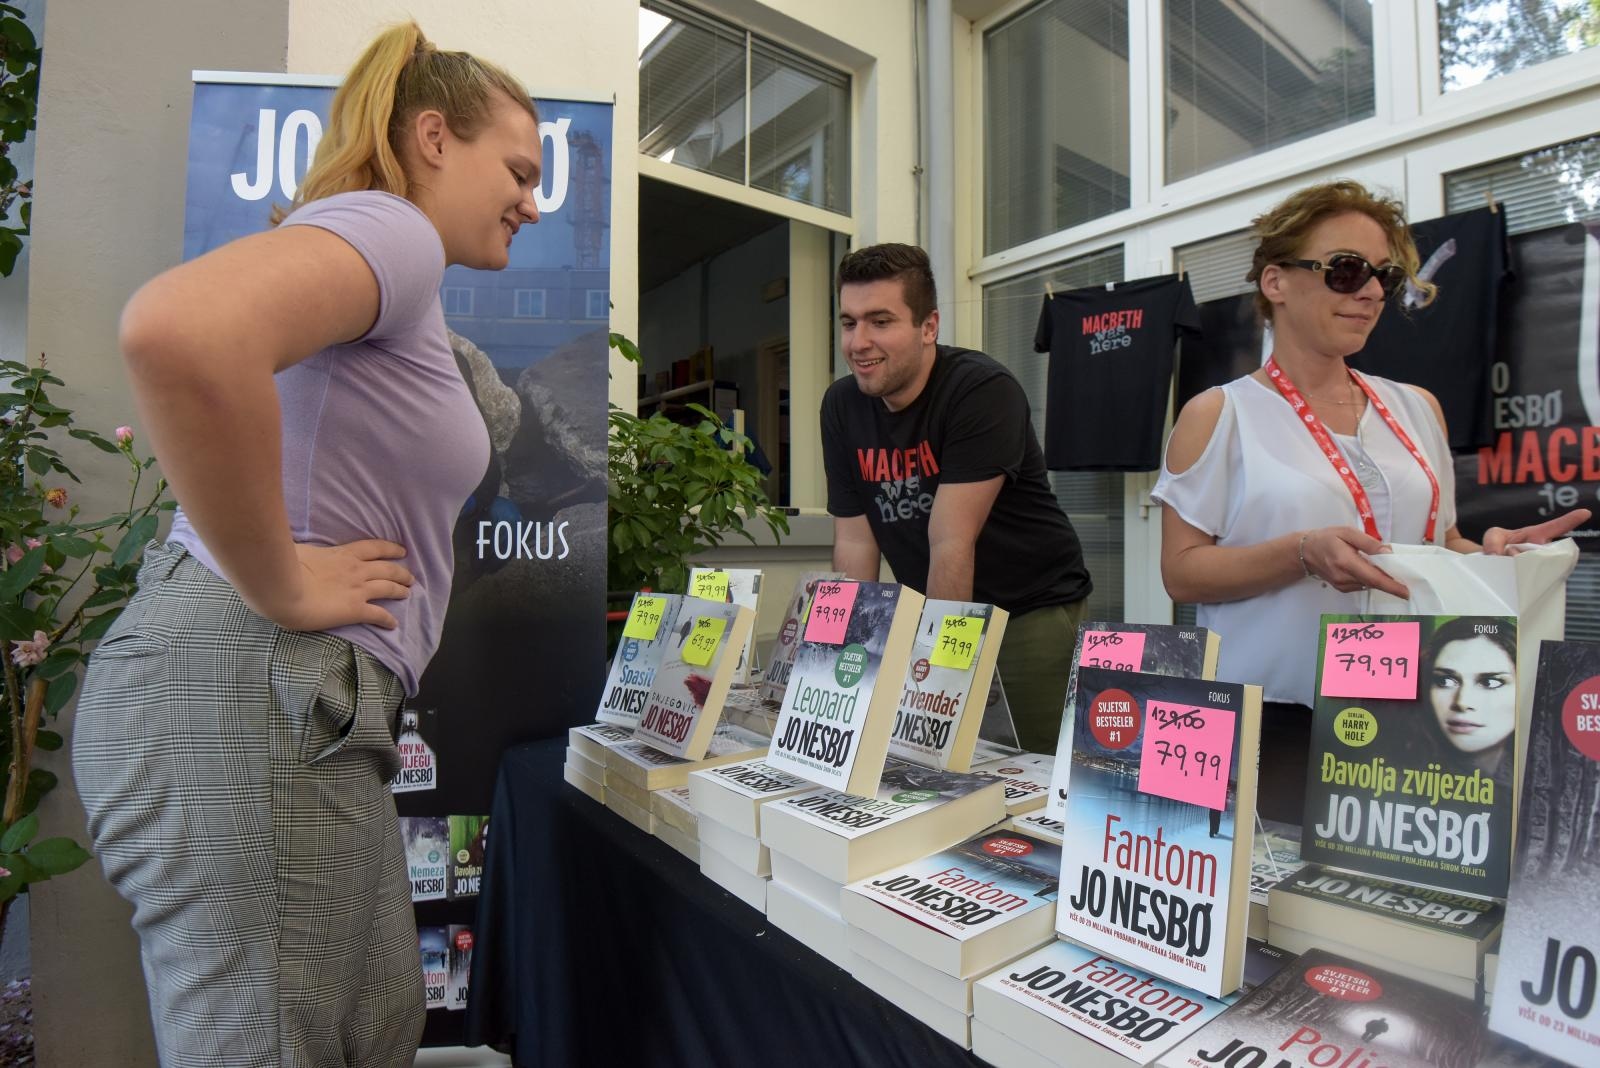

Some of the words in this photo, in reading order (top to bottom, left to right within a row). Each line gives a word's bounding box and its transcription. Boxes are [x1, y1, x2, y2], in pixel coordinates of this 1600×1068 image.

[231, 109, 324, 201] JO
[1082, 309, 1143, 336] MACBETH
[1090, 335, 1131, 355] here
[1491, 361, 1510, 394] O
[1494, 390, 1563, 429] ESBØ
[1538, 483, 1579, 516] je
[476, 520, 569, 561] FOKUS
[697, 584, 726, 598] 79,99
[816, 605, 846, 623] 79,99
[1178, 631, 1196, 640] FOKUS
[1474, 623, 1499, 635] FOKUS
[942, 635, 973, 658] 79,99
[1335, 653, 1409, 678] 79,99
[604, 686, 623, 710] JO
[791, 676, 860, 725] Leopard
[900, 682, 963, 718] rvendać
[1098, 702, 1131, 713] SVJETSKI
[1207, 691, 1231, 704] FOKUS
[641, 704, 660, 731] JO
[654, 708, 694, 743] NESBØ
[1096, 716, 1134, 728] BESTSELER
[1152, 706, 1206, 730] 129,00
[1342, 719, 1369, 731] HARRY
[415, 743, 426, 754] NA
[778, 716, 802, 752] JO
[797, 720, 855, 768] NESBØ
[1109, 731, 1122, 742] #1
[1344, 731, 1366, 742] HOLE
[1155, 740, 1221, 780] 79,99
[403, 767, 433, 784] NESBØ
[1321, 752, 1397, 798] Đavolja
[1402, 763, 1494, 805] zvijezda
[808, 802, 891, 828] NESBØ
[1315, 793, 1362, 843] JO
[1366, 799, 1491, 866] NESBØ
[1103, 814, 1217, 898] Fantom
[410, 866, 445, 878] Nemeza
[414, 877, 444, 894] NESBØ
[927, 867, 1028, 912] Fantom
[872, 875, 920, 892] JO
[901, 884, 1003, 926] NESBØ
[1070, 865, 1107, 918] JO
[1110, 875, 1214, 958] NESBØ
[1297, 876, 1351, 894] JO
[1346, 885, 1482, 926] NESBØ
[1185, 958, 1207, 973] SVIJETA
[1322, 969, 1371, 987] SVJETSKI
[1520, 936, 1597, 1020] JO
[427, 985, 445, 1000] SBØ
[1072, 954, 1204, 1022] Fantom
[1314, 974, 1371, 995] BESTSELER
[1329, 986, 1347, 996] #1
[1009, 965, 1067, 991] JO
[1048, 980, 1180, 1042] NESBØ
[1197, 1038, 1268, 1068] JO
[1279, 1024, 1390, 1068] Poli
